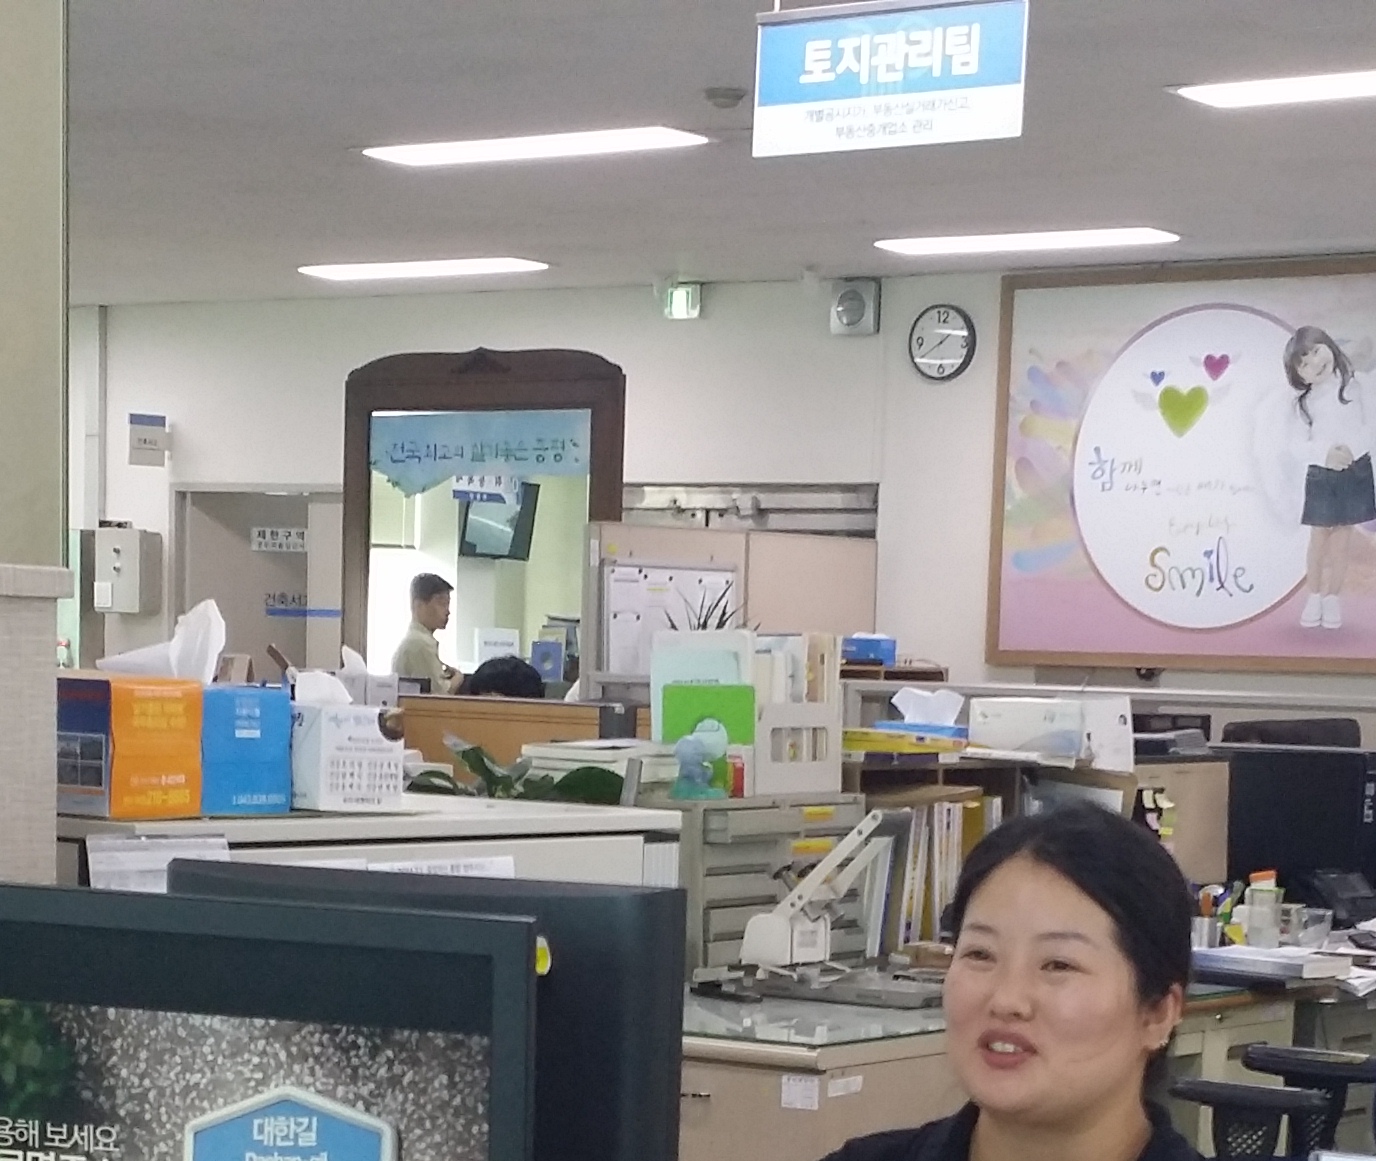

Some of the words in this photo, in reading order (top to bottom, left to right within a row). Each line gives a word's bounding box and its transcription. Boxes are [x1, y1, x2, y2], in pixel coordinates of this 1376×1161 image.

[798, 23, 981, 85] 토지관리팀
[937, 310, 950, 324] 12
[916, 336, 924, 350] 9
[937, 363, 945, 375] 6
[1088, 446, 1144, 493] 함께
[1145, 536, 1255, 598] Smile
[44, 1122, 121, 1153] 보세요
[252, 1116, 318, 1148] 대한길
